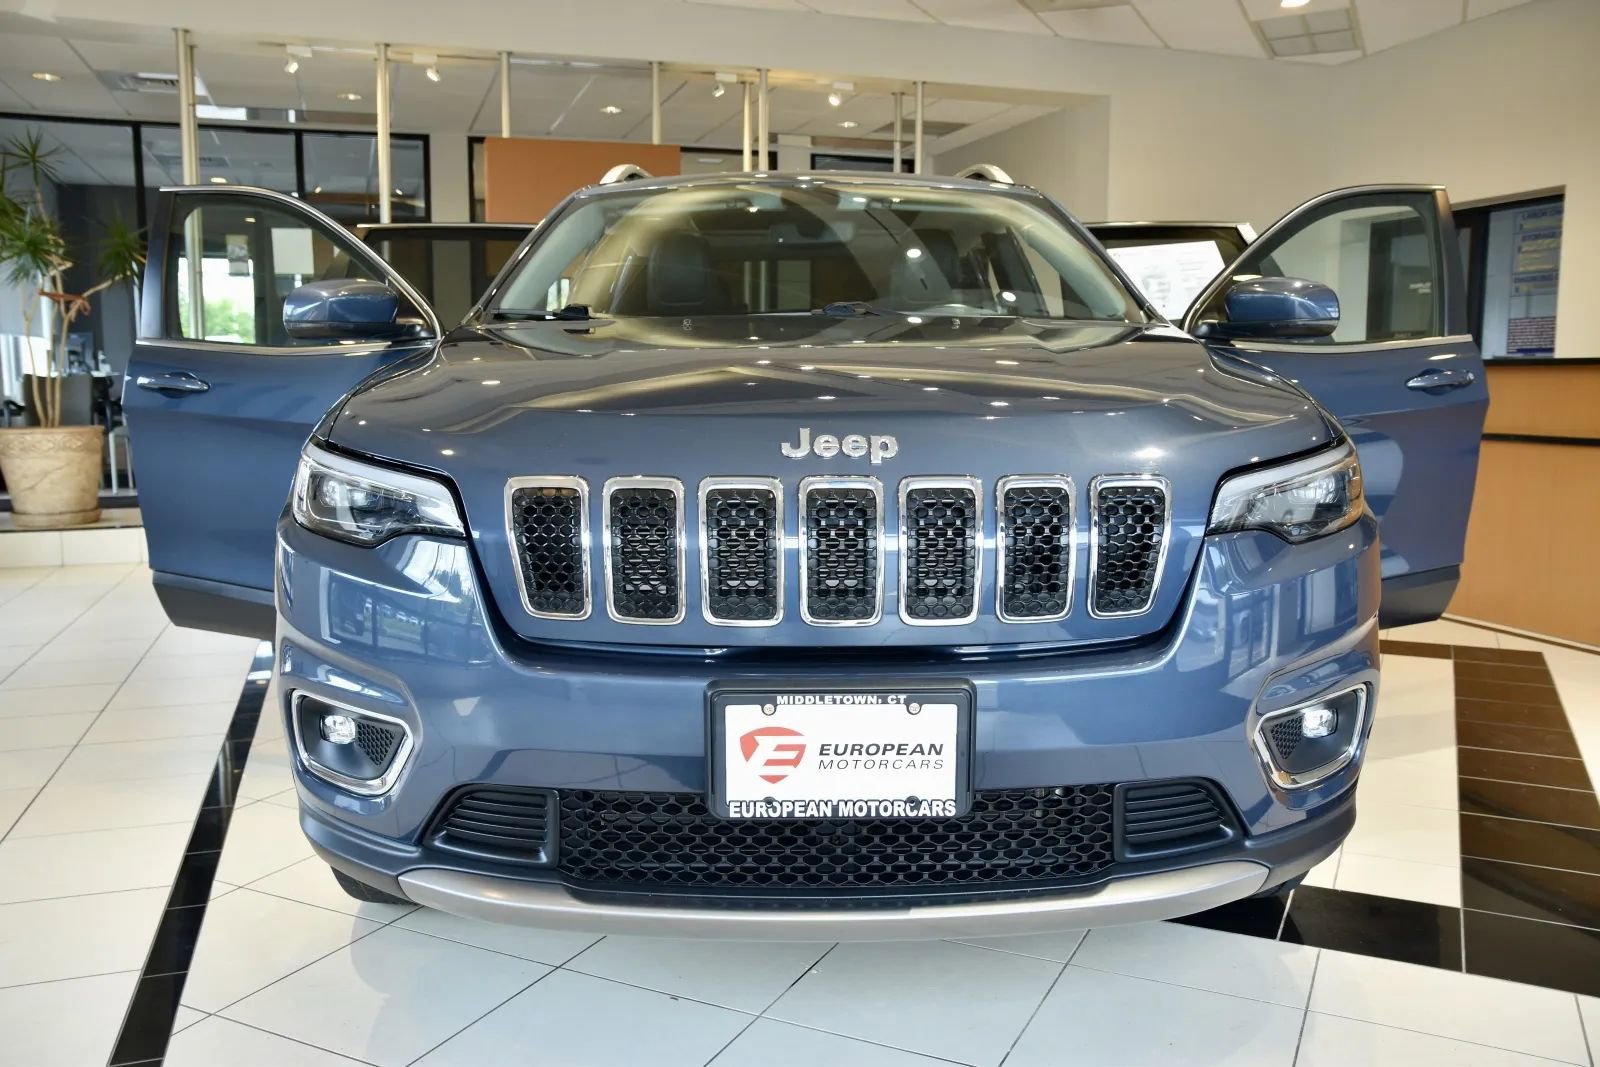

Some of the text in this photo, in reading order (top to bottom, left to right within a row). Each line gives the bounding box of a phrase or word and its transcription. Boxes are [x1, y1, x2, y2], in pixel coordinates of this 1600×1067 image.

[781, 427, 898, 465] Jeep
[887, 694, 908, 705] CT
[819, 743, 944, 757] EUROPEAN
[818, 759, 943, 770] MOTORCARS
[729, 800, 958, 818] EUROPEAN MOTORCARS
